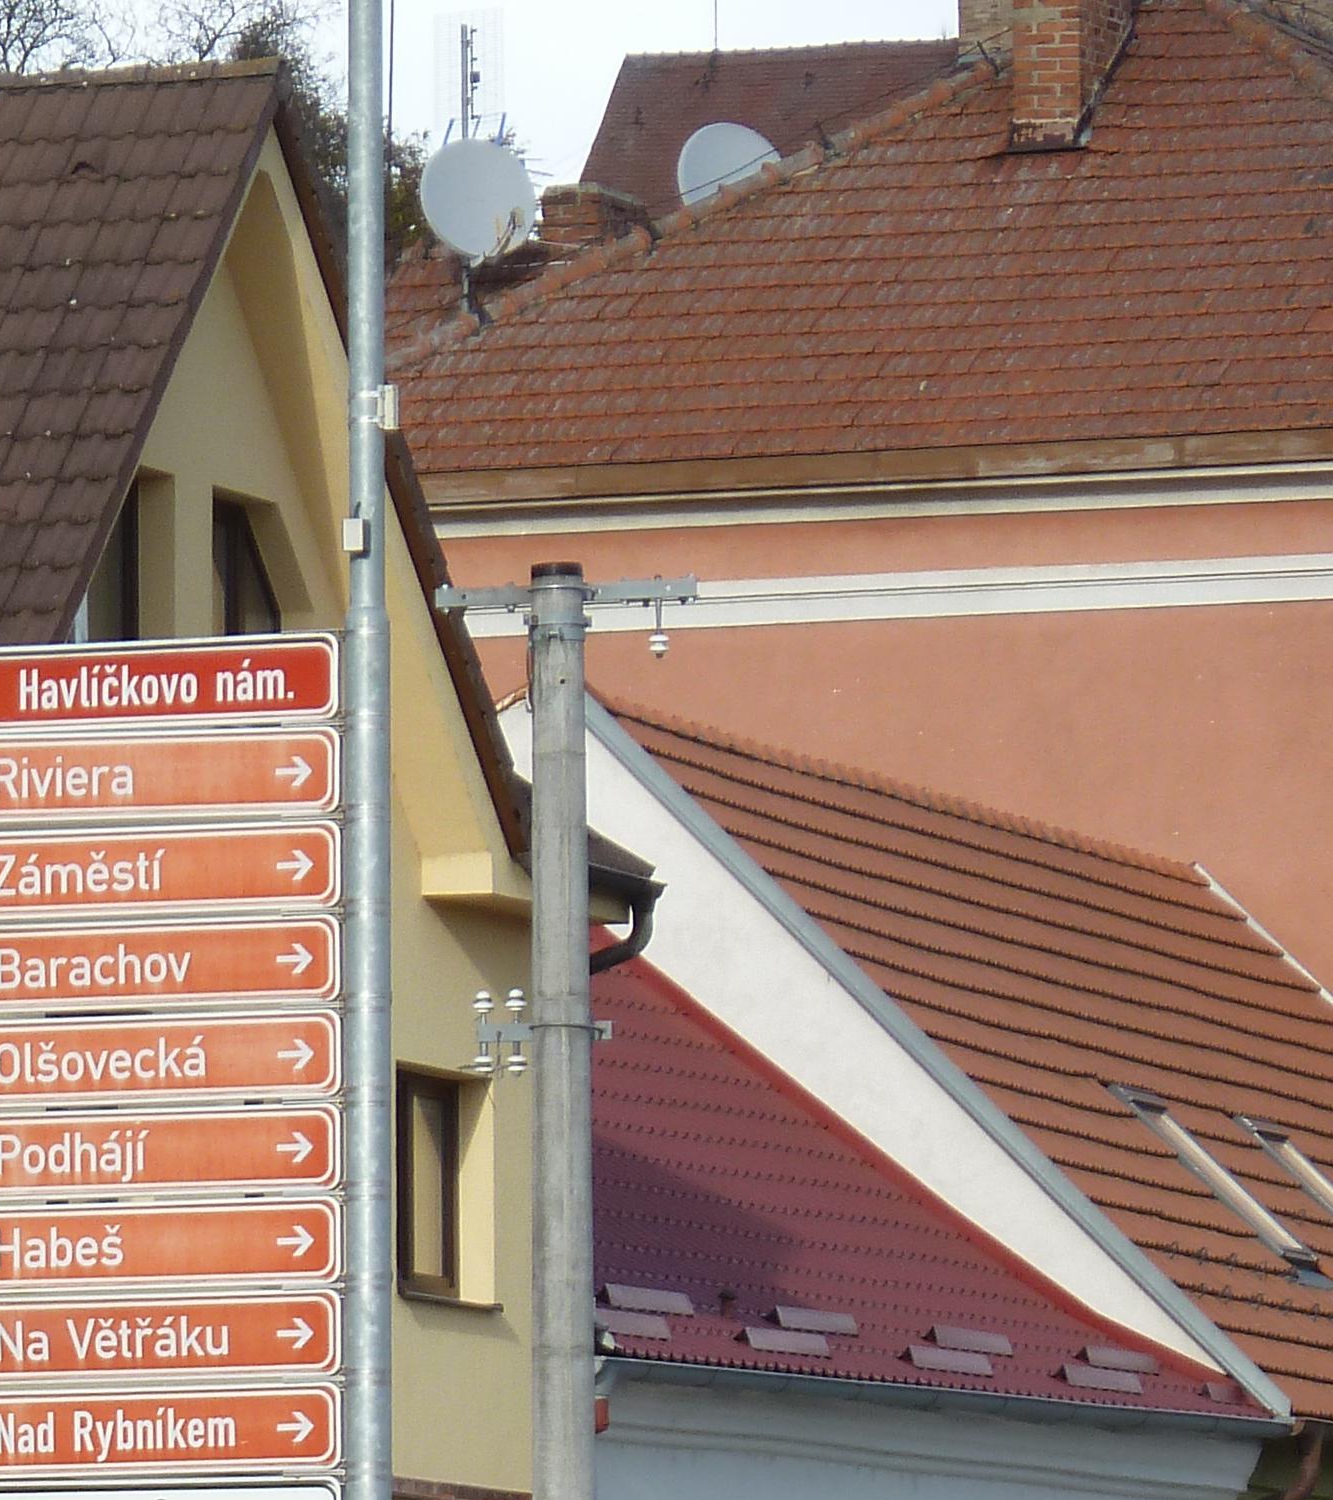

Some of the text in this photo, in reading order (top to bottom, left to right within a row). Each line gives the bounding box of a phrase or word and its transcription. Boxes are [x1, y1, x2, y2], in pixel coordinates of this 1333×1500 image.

[19, 659, 294, 711] Havlíčkovo nám.
[66, 1315, 229, 1360] Větřáku
[73, 1407, 236, 1462] Rybníkem
